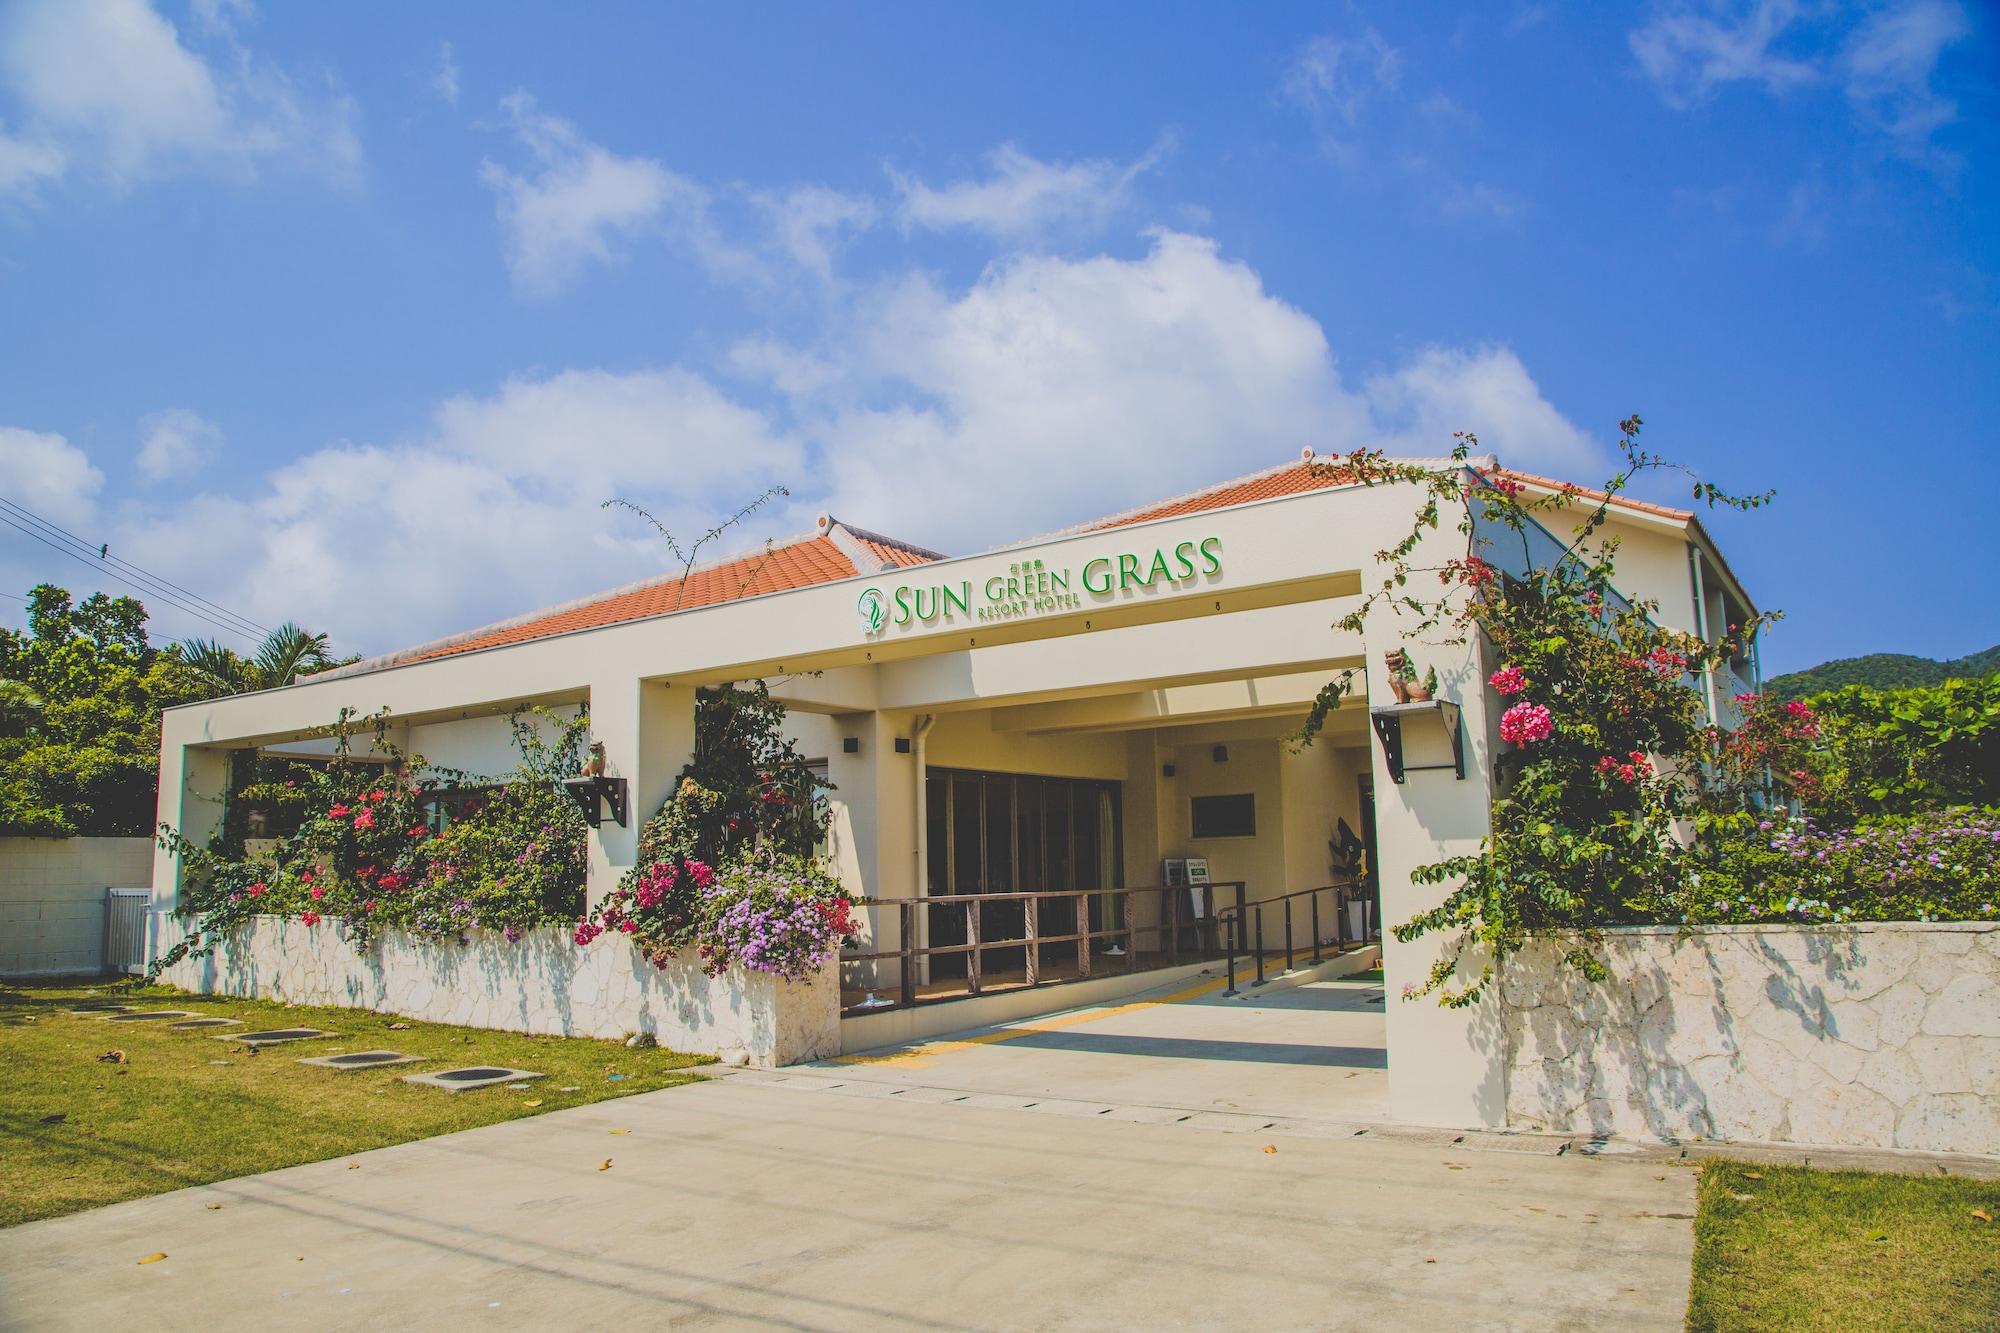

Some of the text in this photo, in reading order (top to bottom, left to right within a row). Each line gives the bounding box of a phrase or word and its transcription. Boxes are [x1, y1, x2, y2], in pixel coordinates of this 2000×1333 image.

[894, 537, 1220, 625] SUN GREEN GRASS
[978, 593, 1079, 619] RESORT HOTEL
